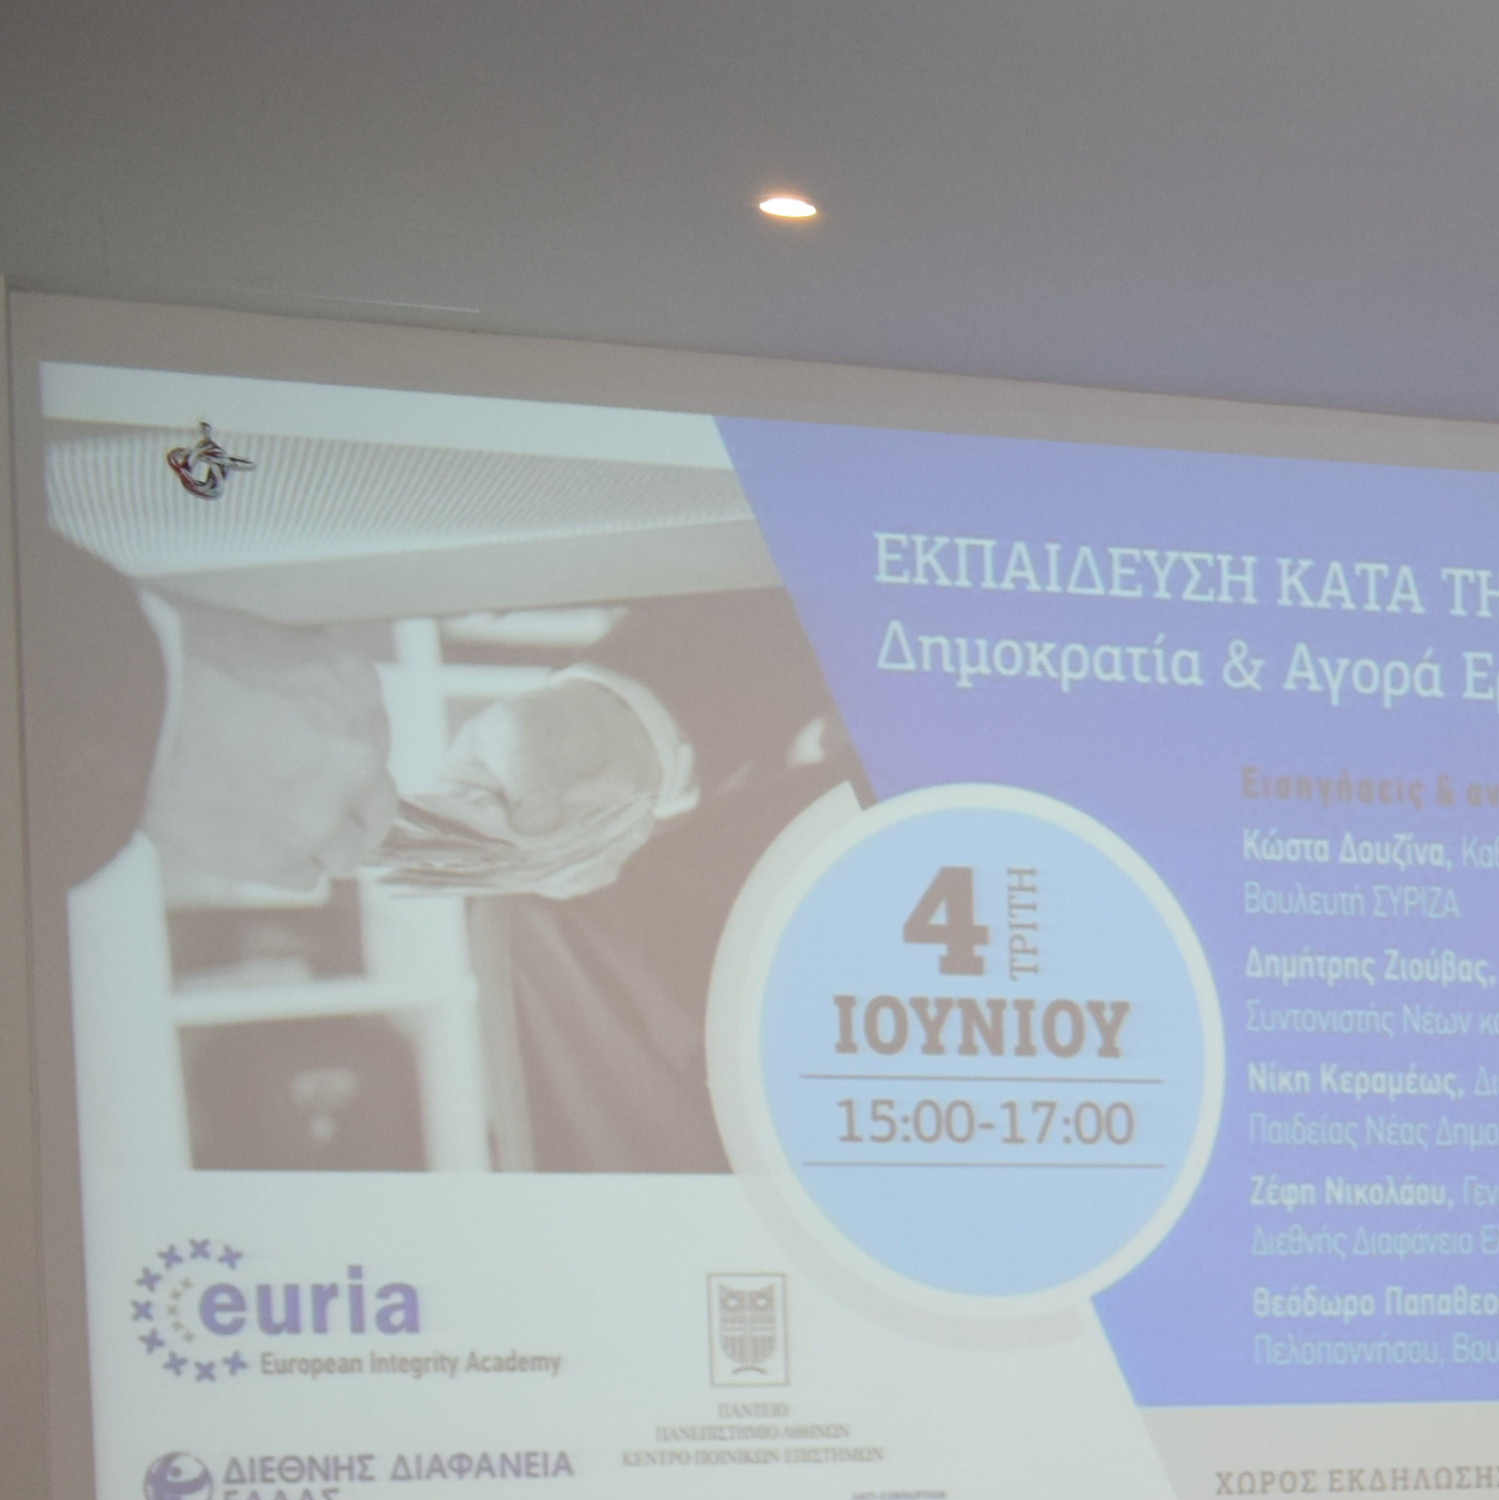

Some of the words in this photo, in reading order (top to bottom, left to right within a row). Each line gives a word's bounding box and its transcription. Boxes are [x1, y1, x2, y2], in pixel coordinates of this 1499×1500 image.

[873, 531, 1257, 605] ΕΚΠΑΙΔΕΥΣΗ
[1276, 557, 1426, 616] ΚΑΤΑ
[877, 618, 1203, 690] Δημοκρατία
[1222, 639, 1264, 689] &
[1283, 644, 1443, 705] Αγορά
[1240, 766, 1423, 810] Εισηγήσεις
[1436, 776, 1456, 805] &
[1243, 828, 1329, 865] Κώστα
[1339, 832, 1453, 871] Δουζίνα,
[1244, 880, 1365, 918] Βουλευτή
[1372, 886, 1460, 918] ΣΥΡΙΖΑ
[903, 866, 990, 976] 4
[1007, 866, 1039, 981] ΤΡΙΤΗ
[1245, 946, 1374, 987] Δημήτρης
[1384, 949, 1496, 988] Ζιούβας,
[833, 995, 1130, 1058] ΙΟΥΝΙΟΥ
[1245, 1000, 1395, 1038] Συντονιστής
[1402, 1003, 1470, 1034] Νέων
[1248, 1062, 1310, 1096] Νίκη
[1320, 1065, 1464, 1102] Κεραμέως,
[836, 1098, 1135, 1145] 15:00-17:00
[1249, 1113, 1357, 1150] Παιδείας
[1365, 1114, 1428, 1149] Νέας
[1250, 1173, 1316, 1210] Ζέφη
[1324, 1175, 1453, 1211] Νικολάου,
[1252, 1225, 1346, 1260] Διεθνής
[1353, 1225, 1473, 1259] Διαφάνεια
[199, 1264, 421, 1335] euria
[1252, 1284, 1374, 1324] Θεόδωρο
[260, 1353, 363, 1379] European
[370, 1351, 459, 1380] Integrity
[465, 1349, 562, 1377] Academy
[223, 1454, 376, 1485] ΔΙΕΘΝΗΣ
[390, 1450, 575, 1481] ΔΙΑΦΑΝΕΙΑ
[1215, 1468, 1317, 1496] ΧΩΡΟΣ
